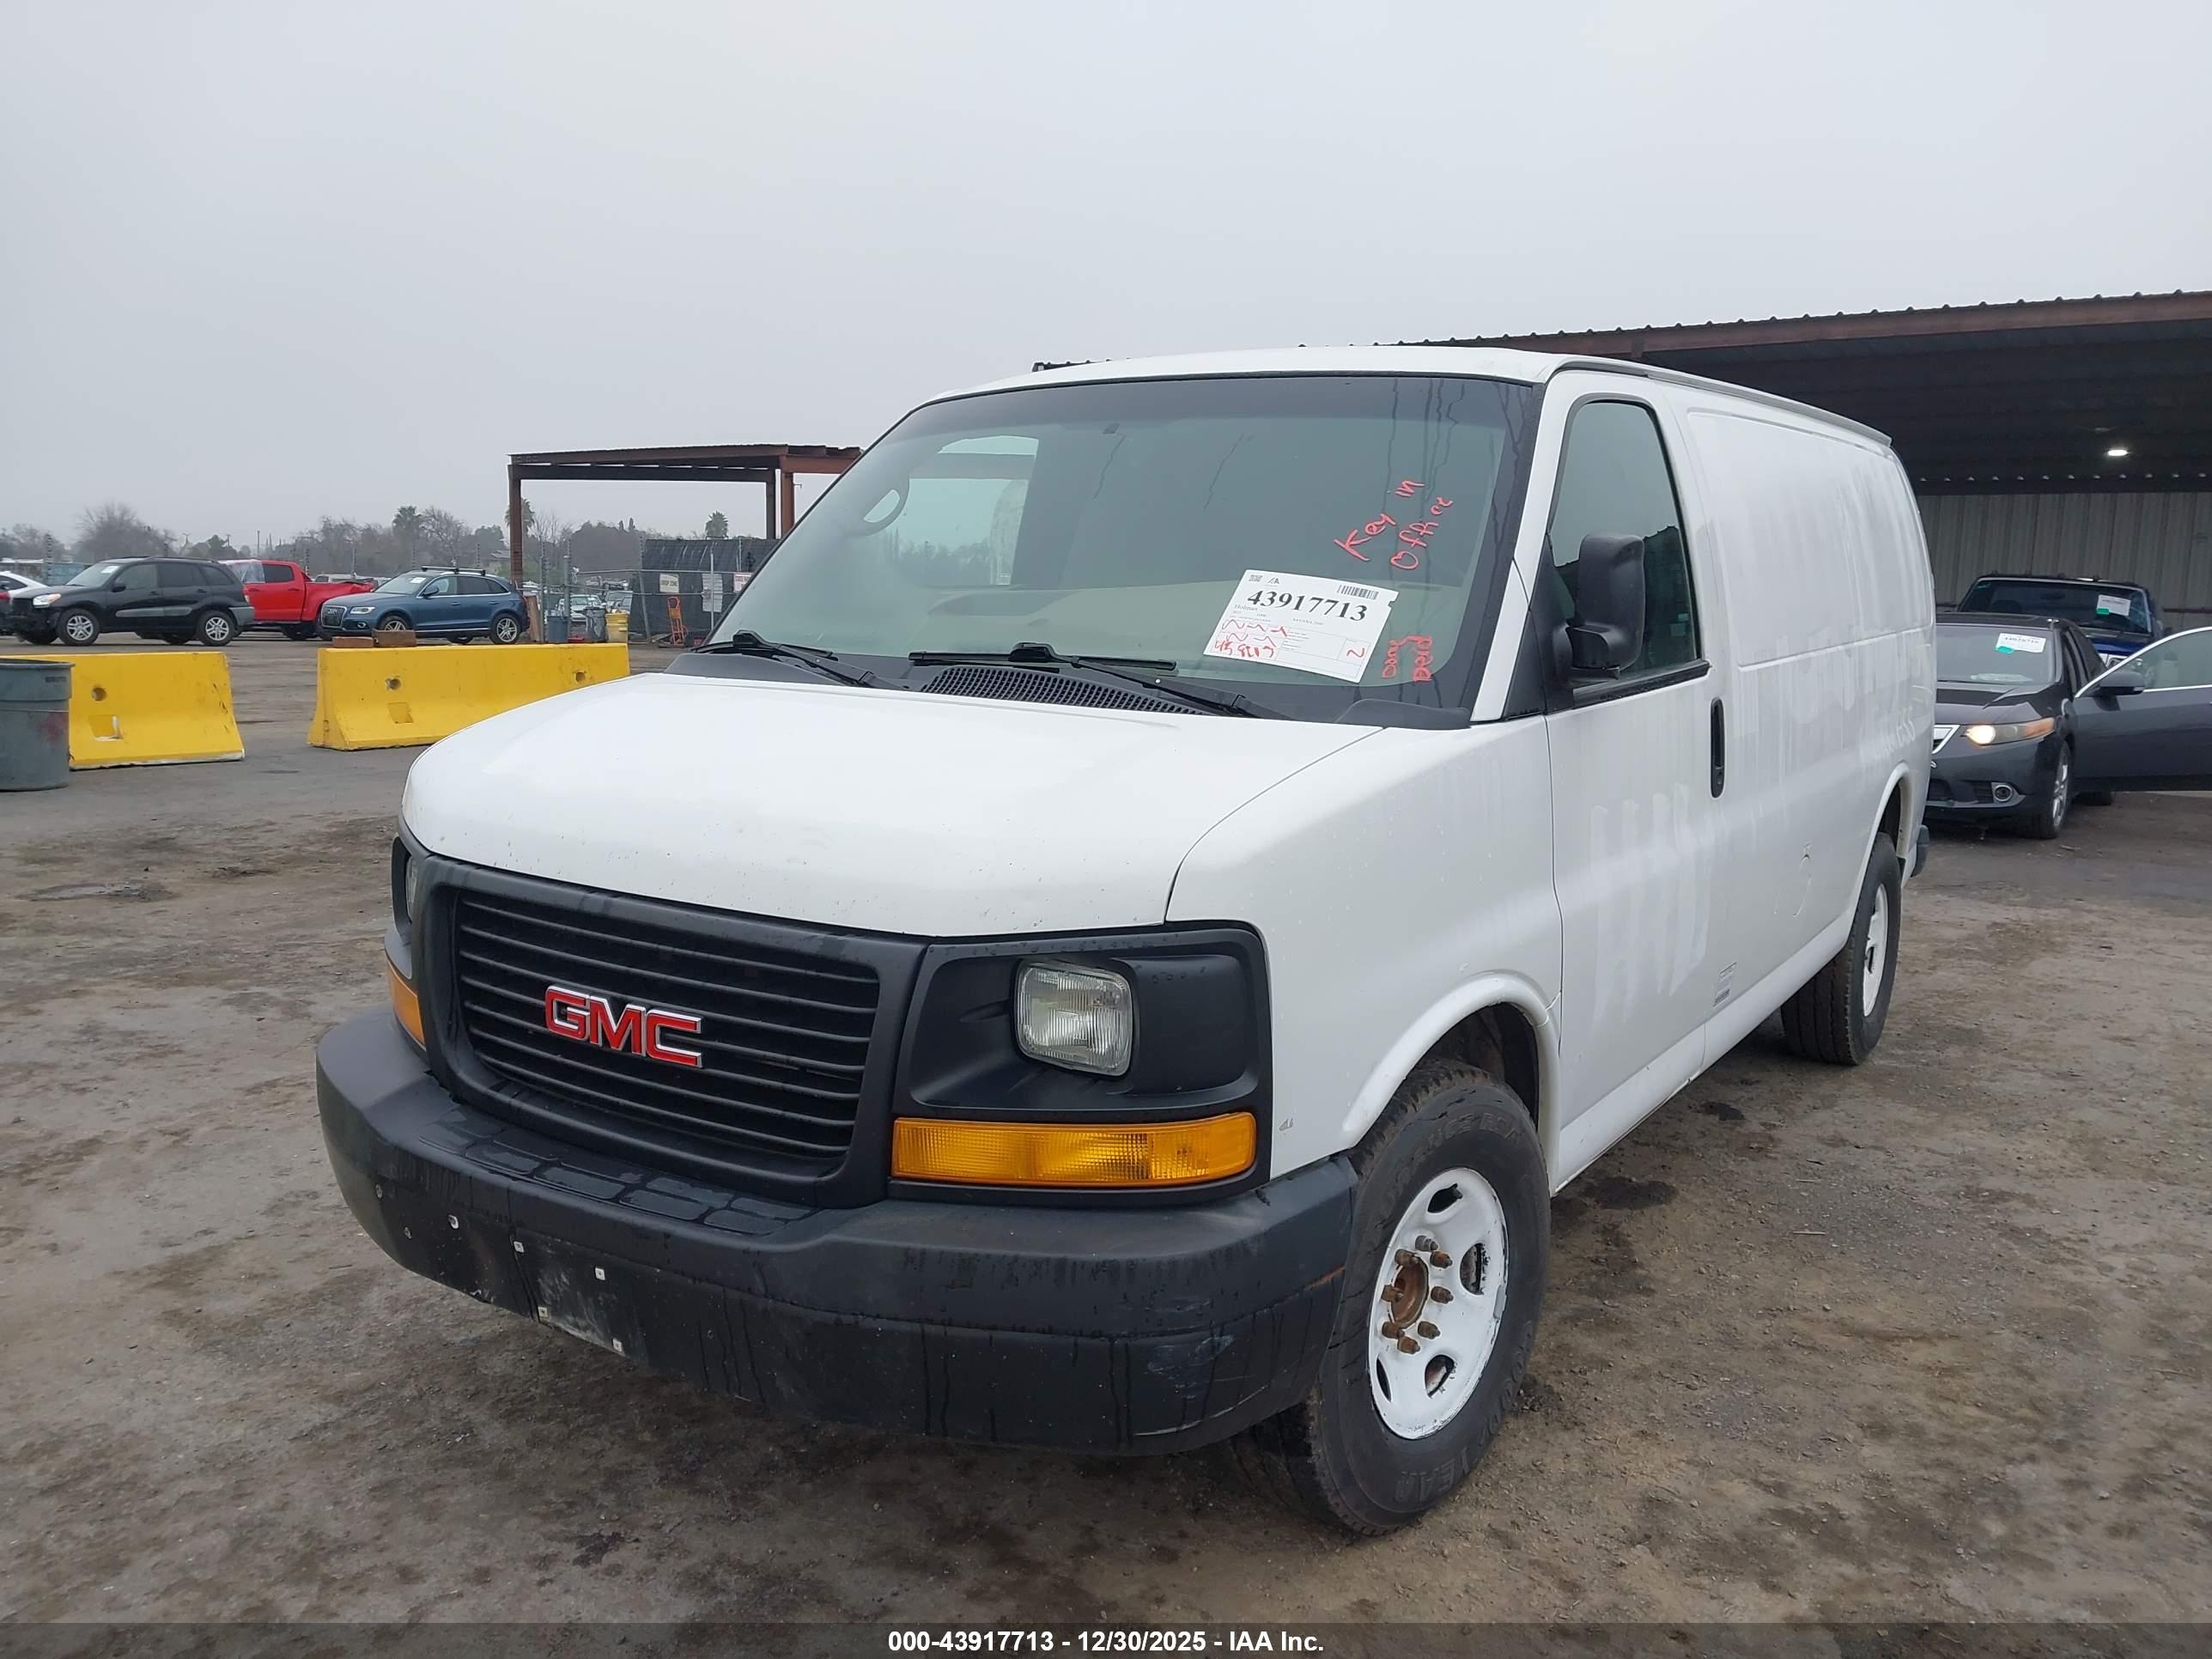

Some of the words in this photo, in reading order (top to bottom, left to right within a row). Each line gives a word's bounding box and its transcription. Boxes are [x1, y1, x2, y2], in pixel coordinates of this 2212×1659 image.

[1334, 514, 1397, 562] Key
[1247, 590, 1368, 622] 43917713
[545, 985, 702, 1068] GMC
